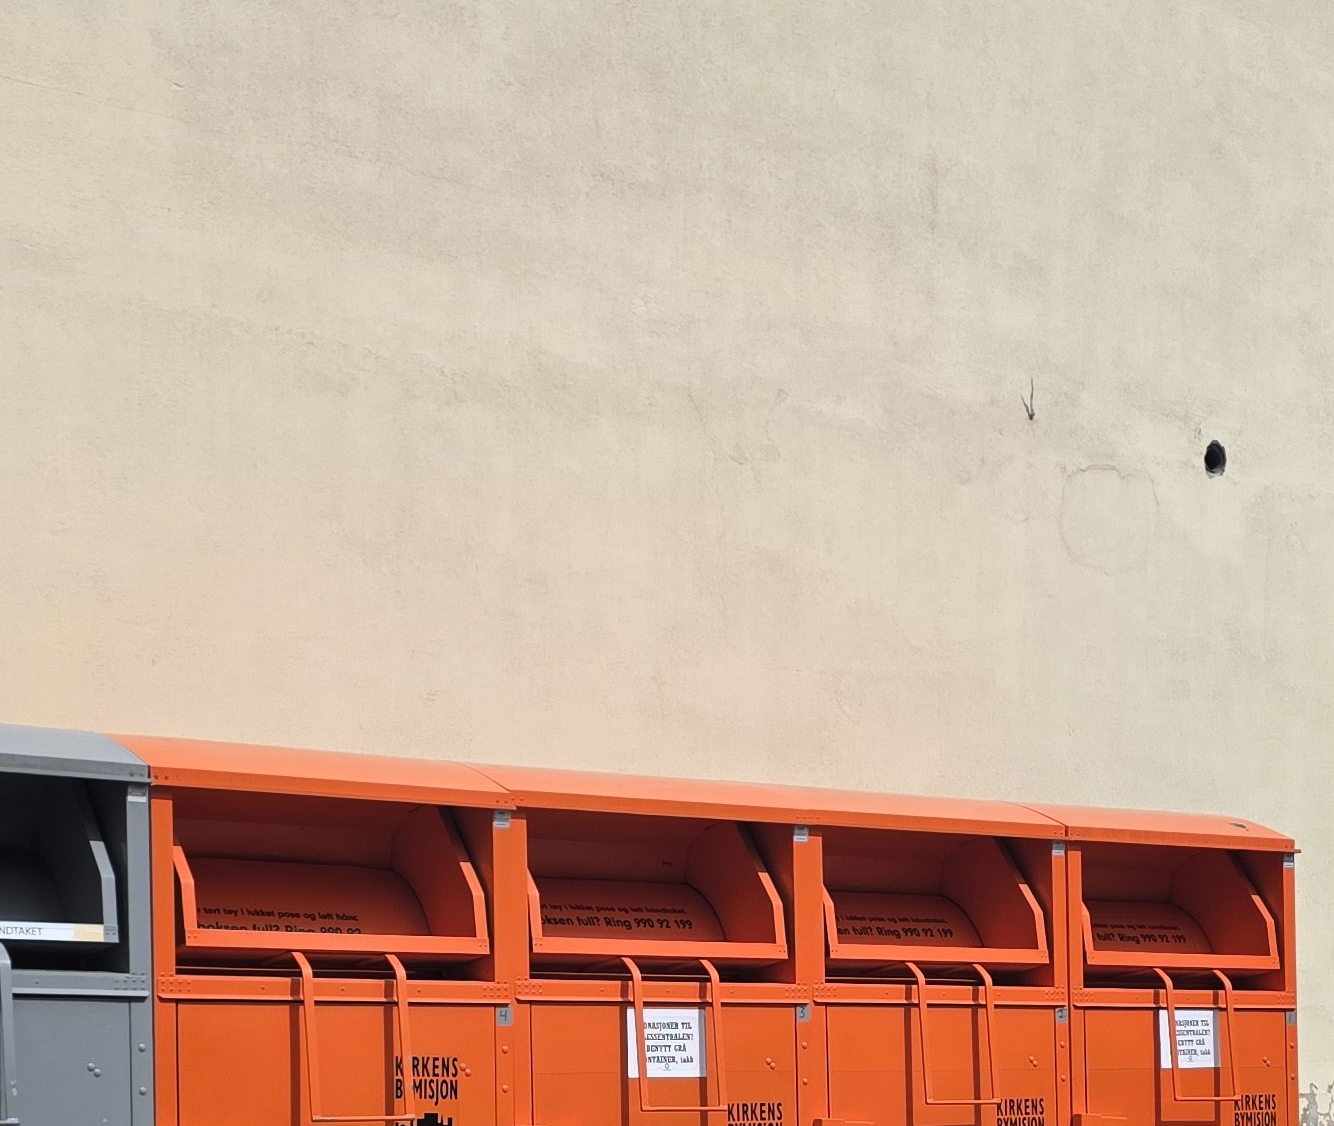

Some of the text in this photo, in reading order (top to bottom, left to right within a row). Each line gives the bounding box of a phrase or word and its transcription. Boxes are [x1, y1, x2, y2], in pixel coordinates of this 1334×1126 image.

[577, 916, 693, 930] full? Ring 990 92 199
[876, 926, 901, 939] Ring
[902, 926, 920, 937] 990
[922, 928, 935, 937] 92
[937, 928, 953, 938] 199
[799, 1006, 806, 1019] 3
[395, 1056, 459, 1078] KRKENS
[395, 1079, 459, 1106] BMISJON
[997, 1098, 1045, 1116] KIRKENS
[1234, 1094, 1277, 1111] KIRKENS
[727, 1102, 783, 1121] KIRKENS
